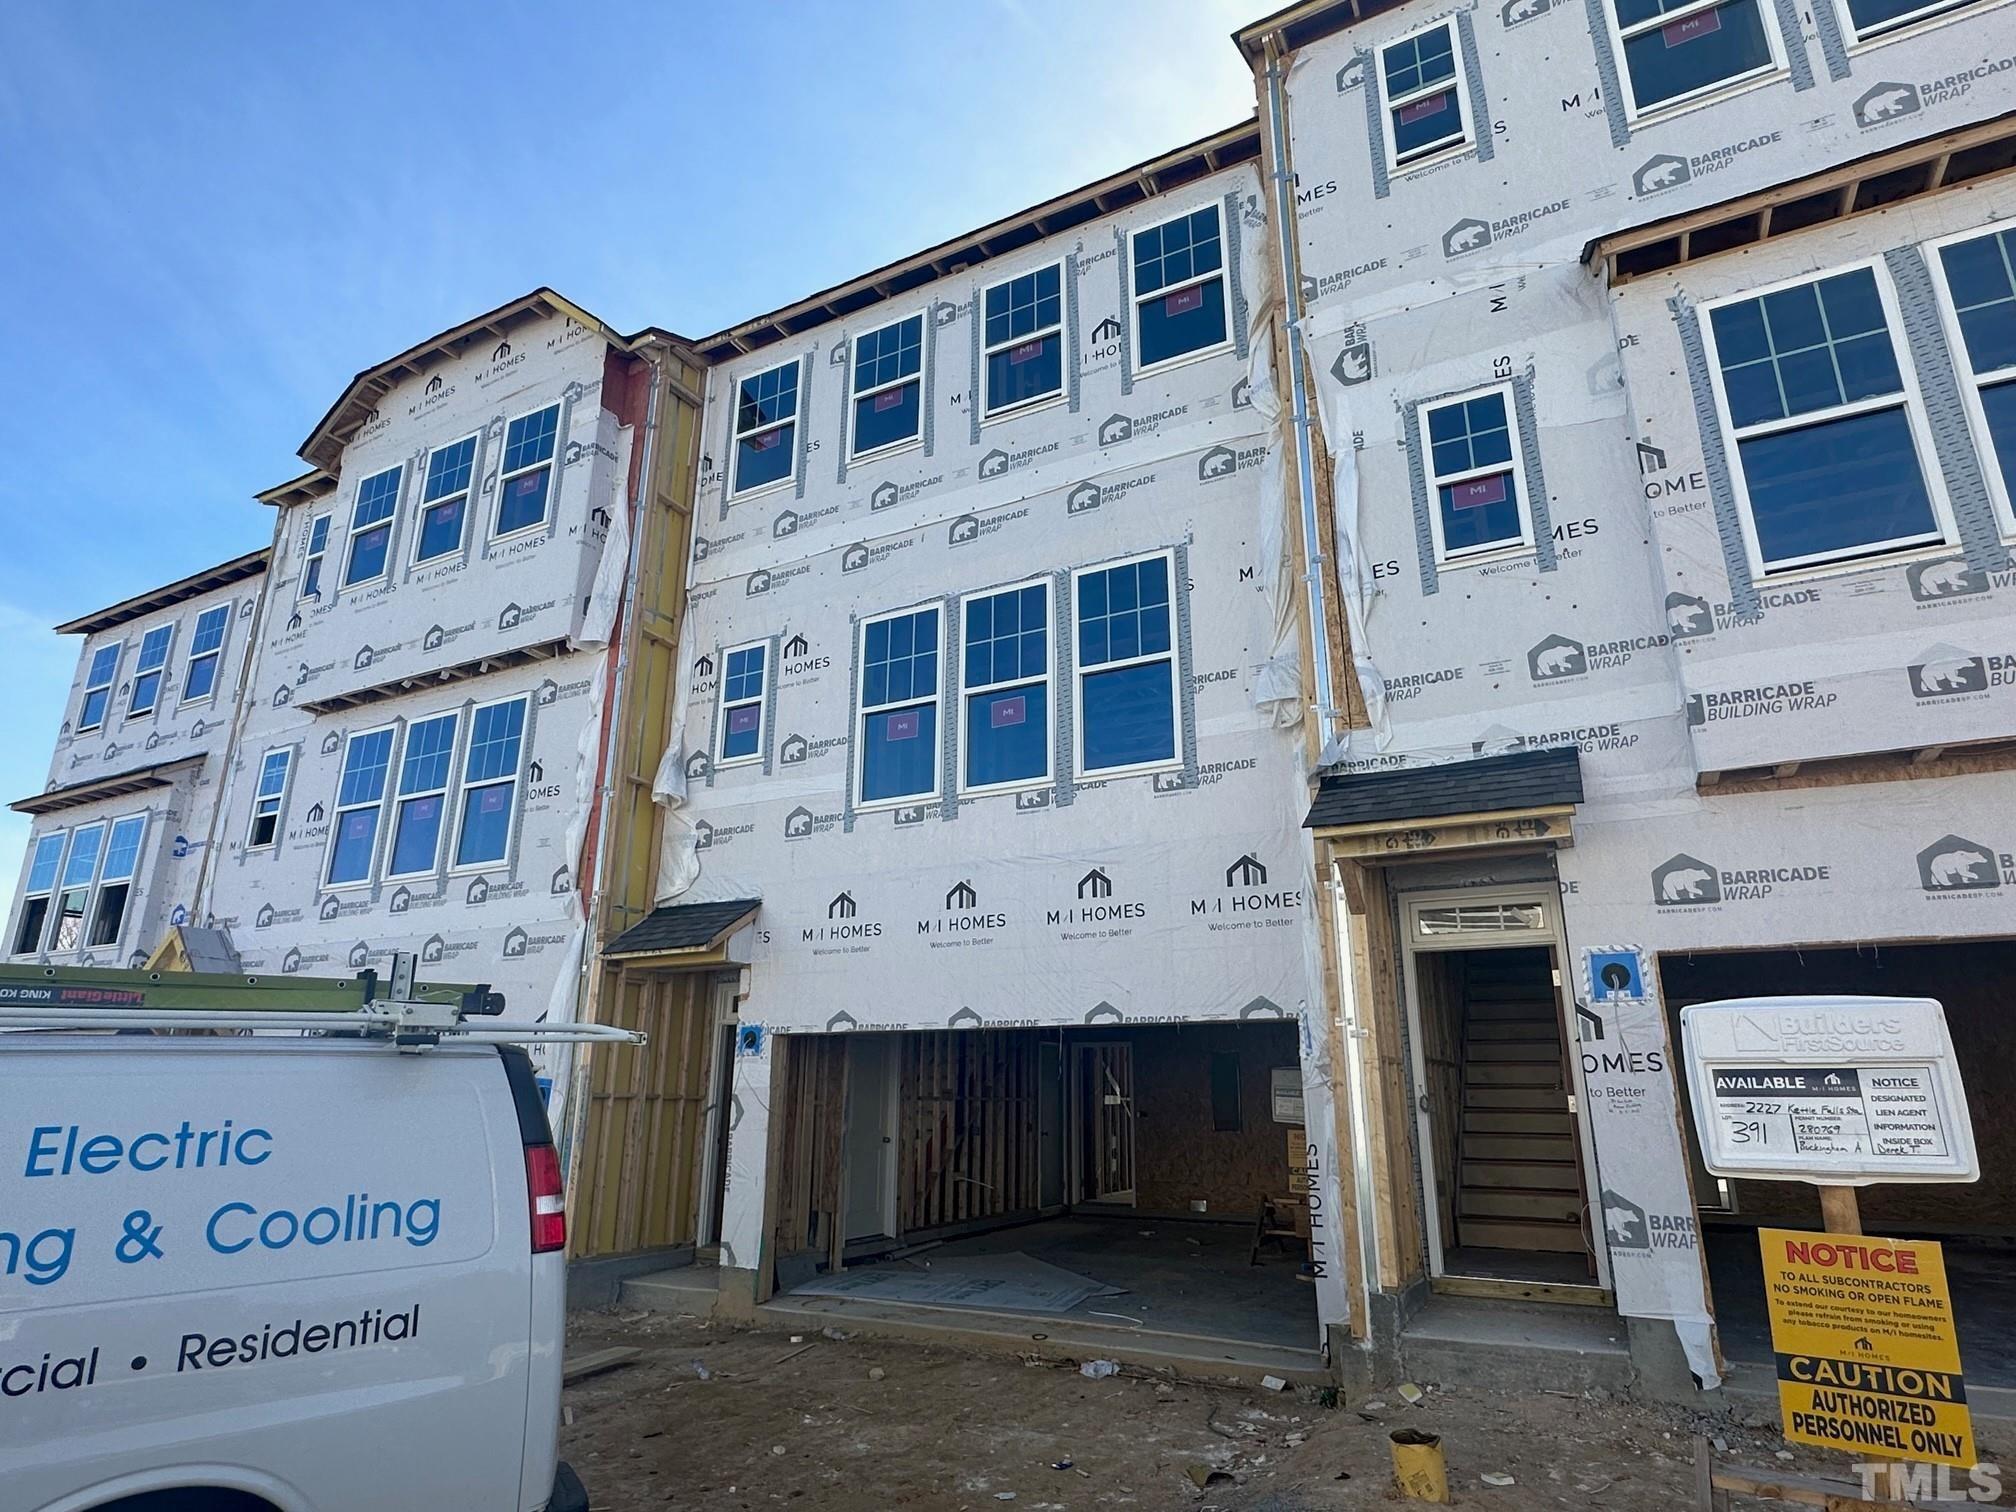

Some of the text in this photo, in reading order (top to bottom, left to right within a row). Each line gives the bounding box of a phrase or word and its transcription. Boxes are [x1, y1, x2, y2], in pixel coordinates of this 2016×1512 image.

[1923, 84, 1971, 107] WRAP
[1691, 131, 1781, 168] BARRICADE
[1404, 163, 1450, 182] Welcome
[1692, 156, 1734, 178] WRAP
[1492, 200, 1571, 233] BARRICADE
[1492, 224, 1529, 242] WRAP
[1320, 258, 1388, 288] BARRICADE
[1320, 280, 1351, 296] WRAP
[1133, 405, 1188, 428] BARRICADE
[1134, 423, 1159, 436] WRAP
[1010, 442, 1059, 462] BARRICADE
[899, 475, 943, 494] BARRICADE
[1102, 474, 1156, 496] BARRICADE
[1469, 484, 1486, 495] MI
[1102, 491, 1127, 505] WRAP
[1668, 500, 1706, 515] Better
[799, 505, 839, 522] BARRICADE
[979, 508, 1029, 528] BARRICADE
[509, 535, 545, 555] HOMES
[869, 539, 914, 556] BARRICADE
[771, 565, 810, 581] BARRICADE
[1479, 560, 1530, 576] Welcome
[785, 657, 830, 676] HOMES
[1589, 653, 1631, 671] WRAP
[1384, 668, 1463, 691] BARRICADE
[1385, 687, 1421, 702] WRAP
[1706, 681, 1815, 707] BARRICADE
[1708, 693, 1837, 721] BUILDING WRAP
[1528, 724, 1620, 745] BARRICADE
[1598, 735, 1638, 751] WRAP
[808, 749, 829, 759] WRAP
[714, 824, 754, 837] BARRICADE
[813, 823, 835, 833] WRAP
[1721, 866, 1830, 885] BARRICADE
[1233, 891, 1301, 911] HOMES
[1723, 885, 1772, 900] WRAP
[1082, 903, 1145, 922] HOMES
[830, 923, 882, 940] HOMES
[949, 913, 1006, 932] HOMES
[1208, 918, 1293, 932] Welcome to Better
[528, 935, 567, 945] BARRICADE
[930, 940, 962, 949] Welcome
[972, 937, 994, 946] Better
[1061, 928, 1132, 941] Welcome to Better
[20, 989, 52, 999] KING
[1777, 1014, 1901, 1035] Builders
[1780, 1037, 1904, 1053] FirstSource
[1717, 1077, 1806, 1089] AVAILABLE
[1872, 1078, 1919, 1087] NOTICE
[1590, 1087, 1646, 1098] to Better
[1745, 1102, 1781, 1114] 2227
[1821, 1105, 1844, 1115] Falls
[1731, 1122, 1766, 1144] 391
[1799, 1125, 1840, 1134] 280769
[1874, 1123, 1936, 1131] INFORMATION
[24, 1119, 273, 1177] Electric
[1799, 1142, 1862, 1154] Buckingham A
[1307, 1143, 1324, 1228] HOMES
[115, 1209, 164, 1264] &
[206, 1193, 441, 1255] Cooling
[1785, 1240, 1919, 1275] NOTICE
[1780, 1271, 1931, 1294] TO ALL SUBCONTRACTORS
[1774, 1283, 1944, 1309] NO SMOKING OR OPEN FLAME
[1786, 1300, 1813, 1309] extend
[1830, 1305, 1864, 1314] courtesy
[1893, 1311, 1946, 1323] homeowners
[1788, 1310, 1813, 1319] please
[1815, 1312, 1842, 1320] refrain
[1843, 1315, 1862, 1323] from
[1864, 1318, 1899, 1328] smoking
[1912, 1323, 1935, 1332] using
[1783, 1318, 1796, 1326] any
[1799, 1319, 1830, 1328] tobacco
[1832, 1322, 1868, 1333] products
[177, 1304, 420, 1372] Residential
[1858, 1351, 1890, 1361] HOMES
[1790, 1356, 1952, 1400] CAUTION
[1812, 1389, 1936, 1426] AUTHORIZED
[1792, 1412, 1963, 1458] PERSONNEL ONLY
